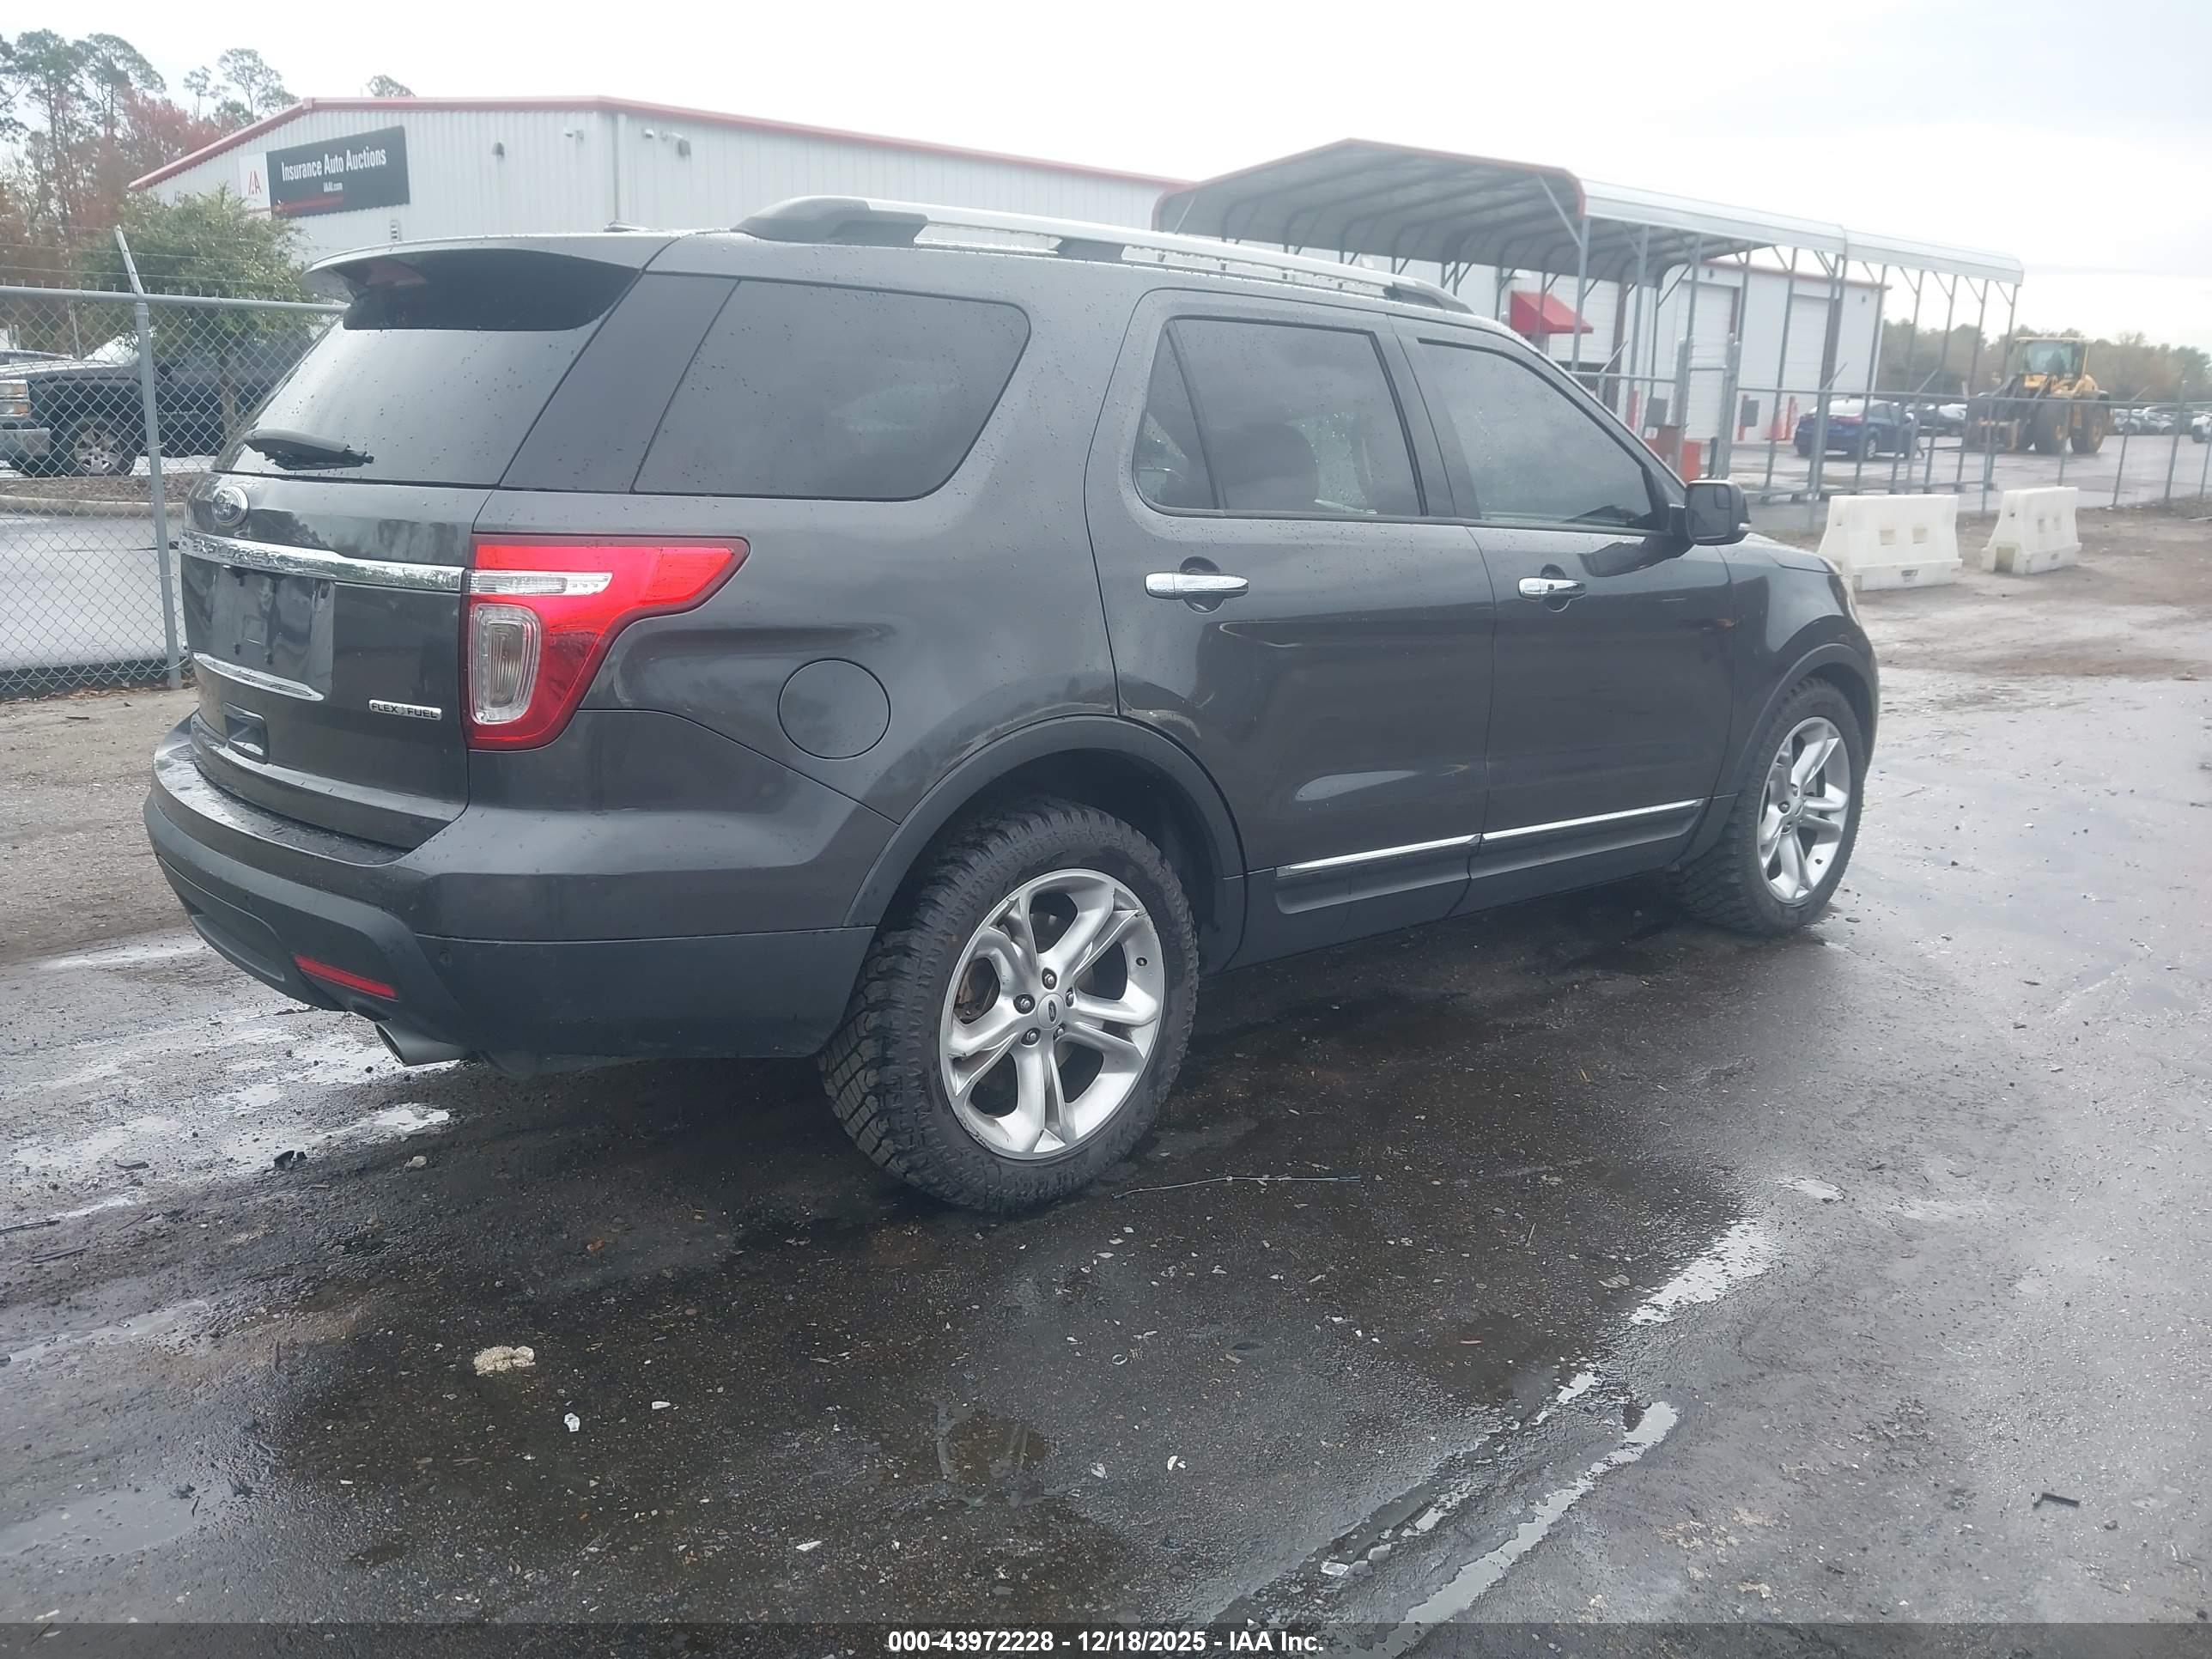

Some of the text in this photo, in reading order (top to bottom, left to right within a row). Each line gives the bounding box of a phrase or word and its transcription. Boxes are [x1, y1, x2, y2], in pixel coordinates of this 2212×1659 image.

[282, 147, 386, 181] Insurance Auto Auctions
[371, 702, 438, 719] FLEX FUEL
